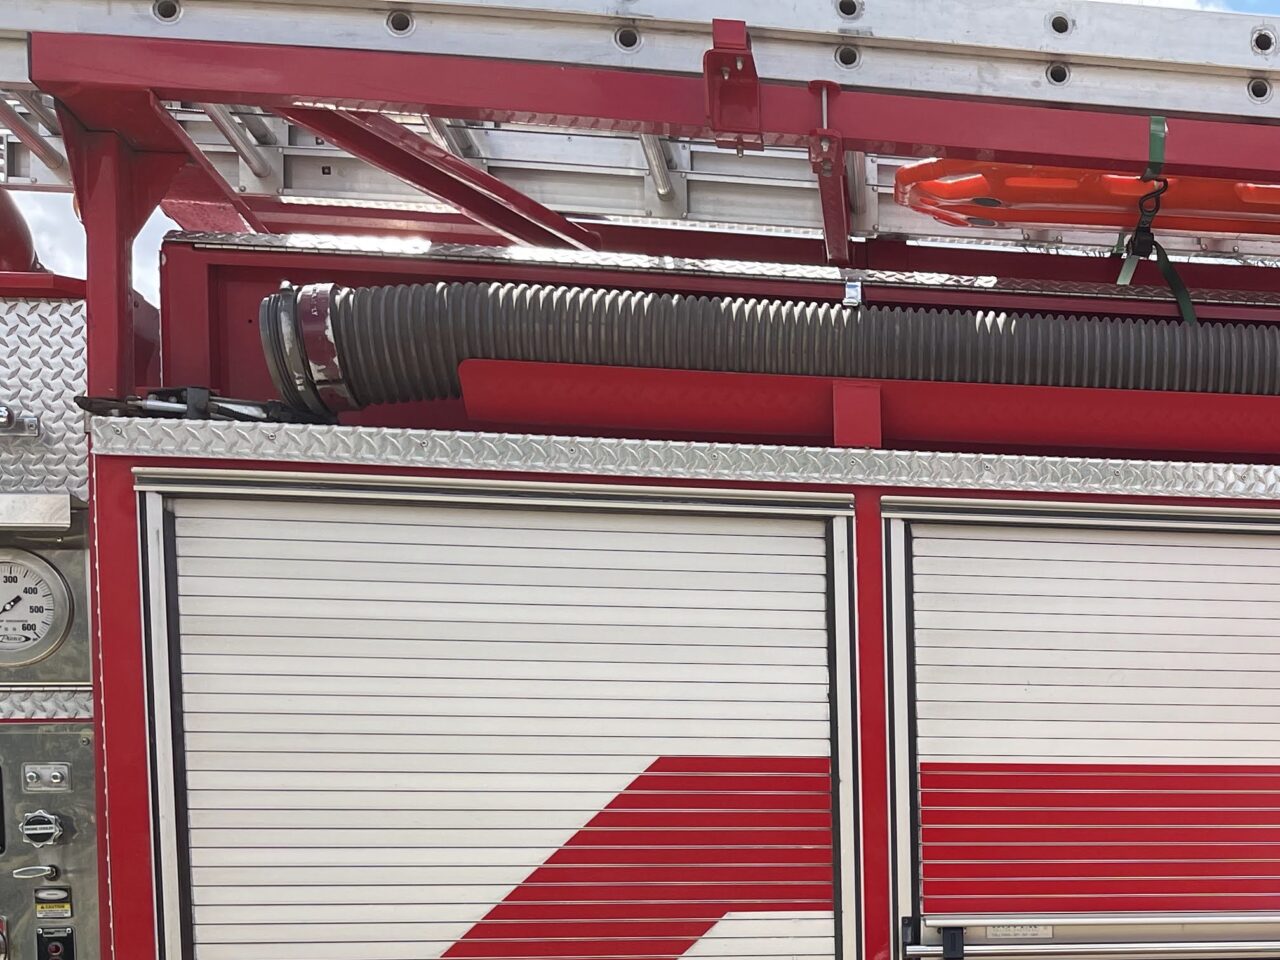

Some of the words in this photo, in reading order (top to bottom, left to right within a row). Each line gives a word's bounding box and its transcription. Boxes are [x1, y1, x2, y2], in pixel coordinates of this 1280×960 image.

[3, 576, 18, 584] 300
[23, 587, 38, 595] 400
[29, 605, 44, 613] 500
[22, 623, 37, 631] 600
